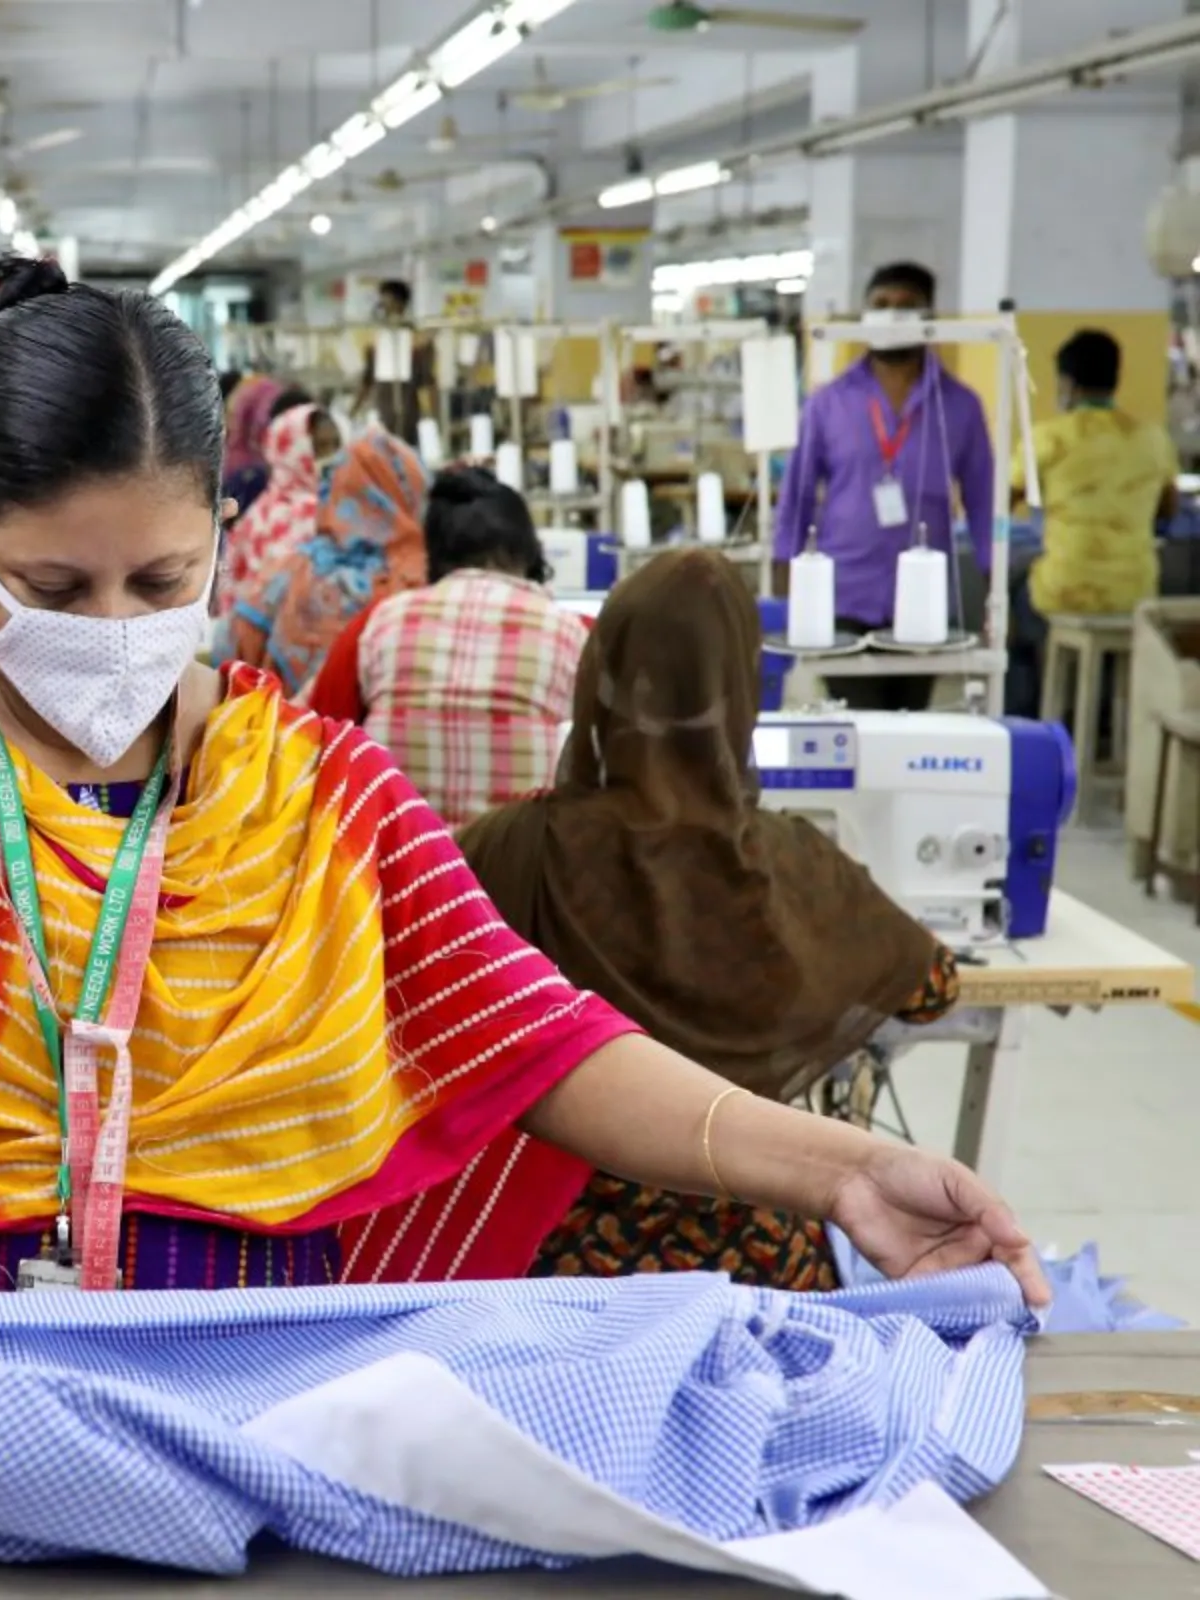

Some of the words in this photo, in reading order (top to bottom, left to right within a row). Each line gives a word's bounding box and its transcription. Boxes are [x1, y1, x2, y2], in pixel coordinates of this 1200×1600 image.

[16, 888, 34, 928] WORK
[83, 958, 109, 1011] NEEDLE
[97, 914, 120, 955] WORK
